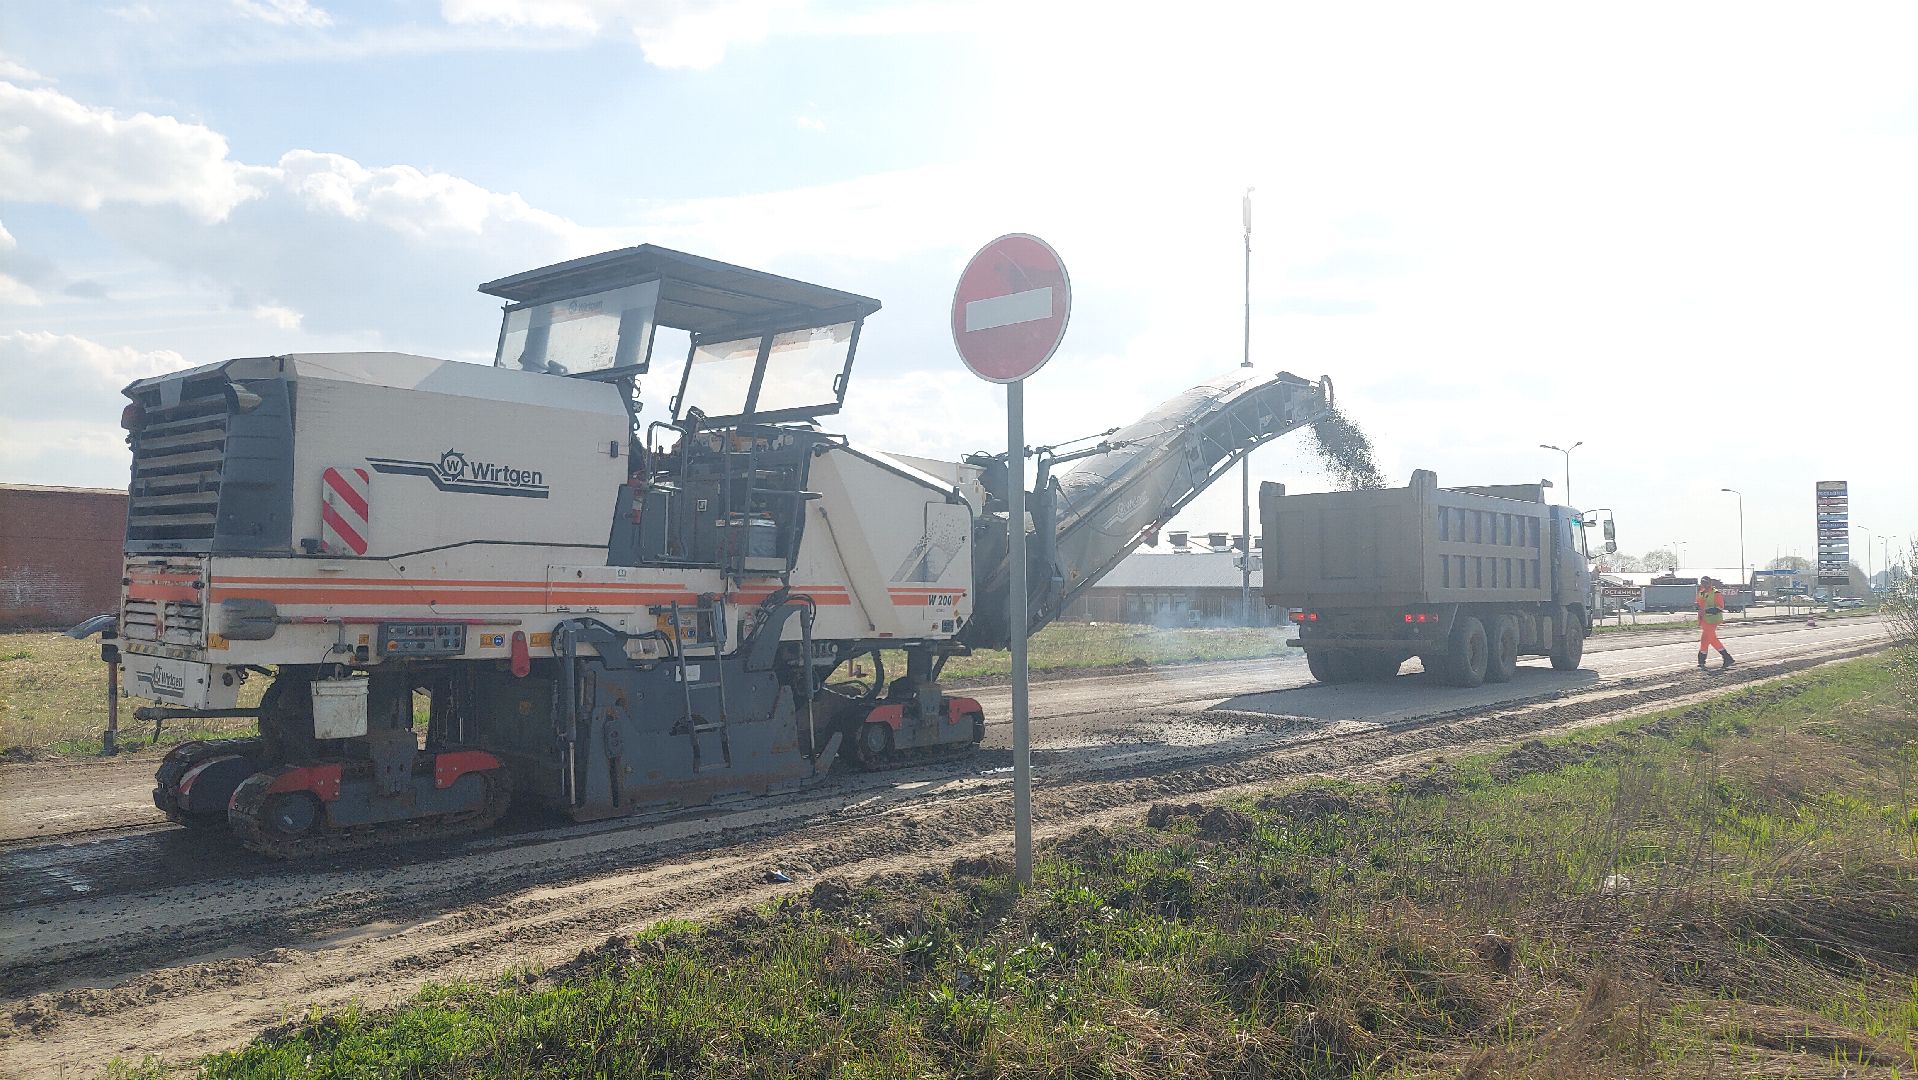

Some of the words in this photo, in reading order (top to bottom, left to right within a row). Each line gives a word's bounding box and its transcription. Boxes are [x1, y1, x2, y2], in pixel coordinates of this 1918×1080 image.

[470, 461, 543, 487] Wirtgen
[928, 594, 937, 606] W
[937, 594, 952, 606] 200
